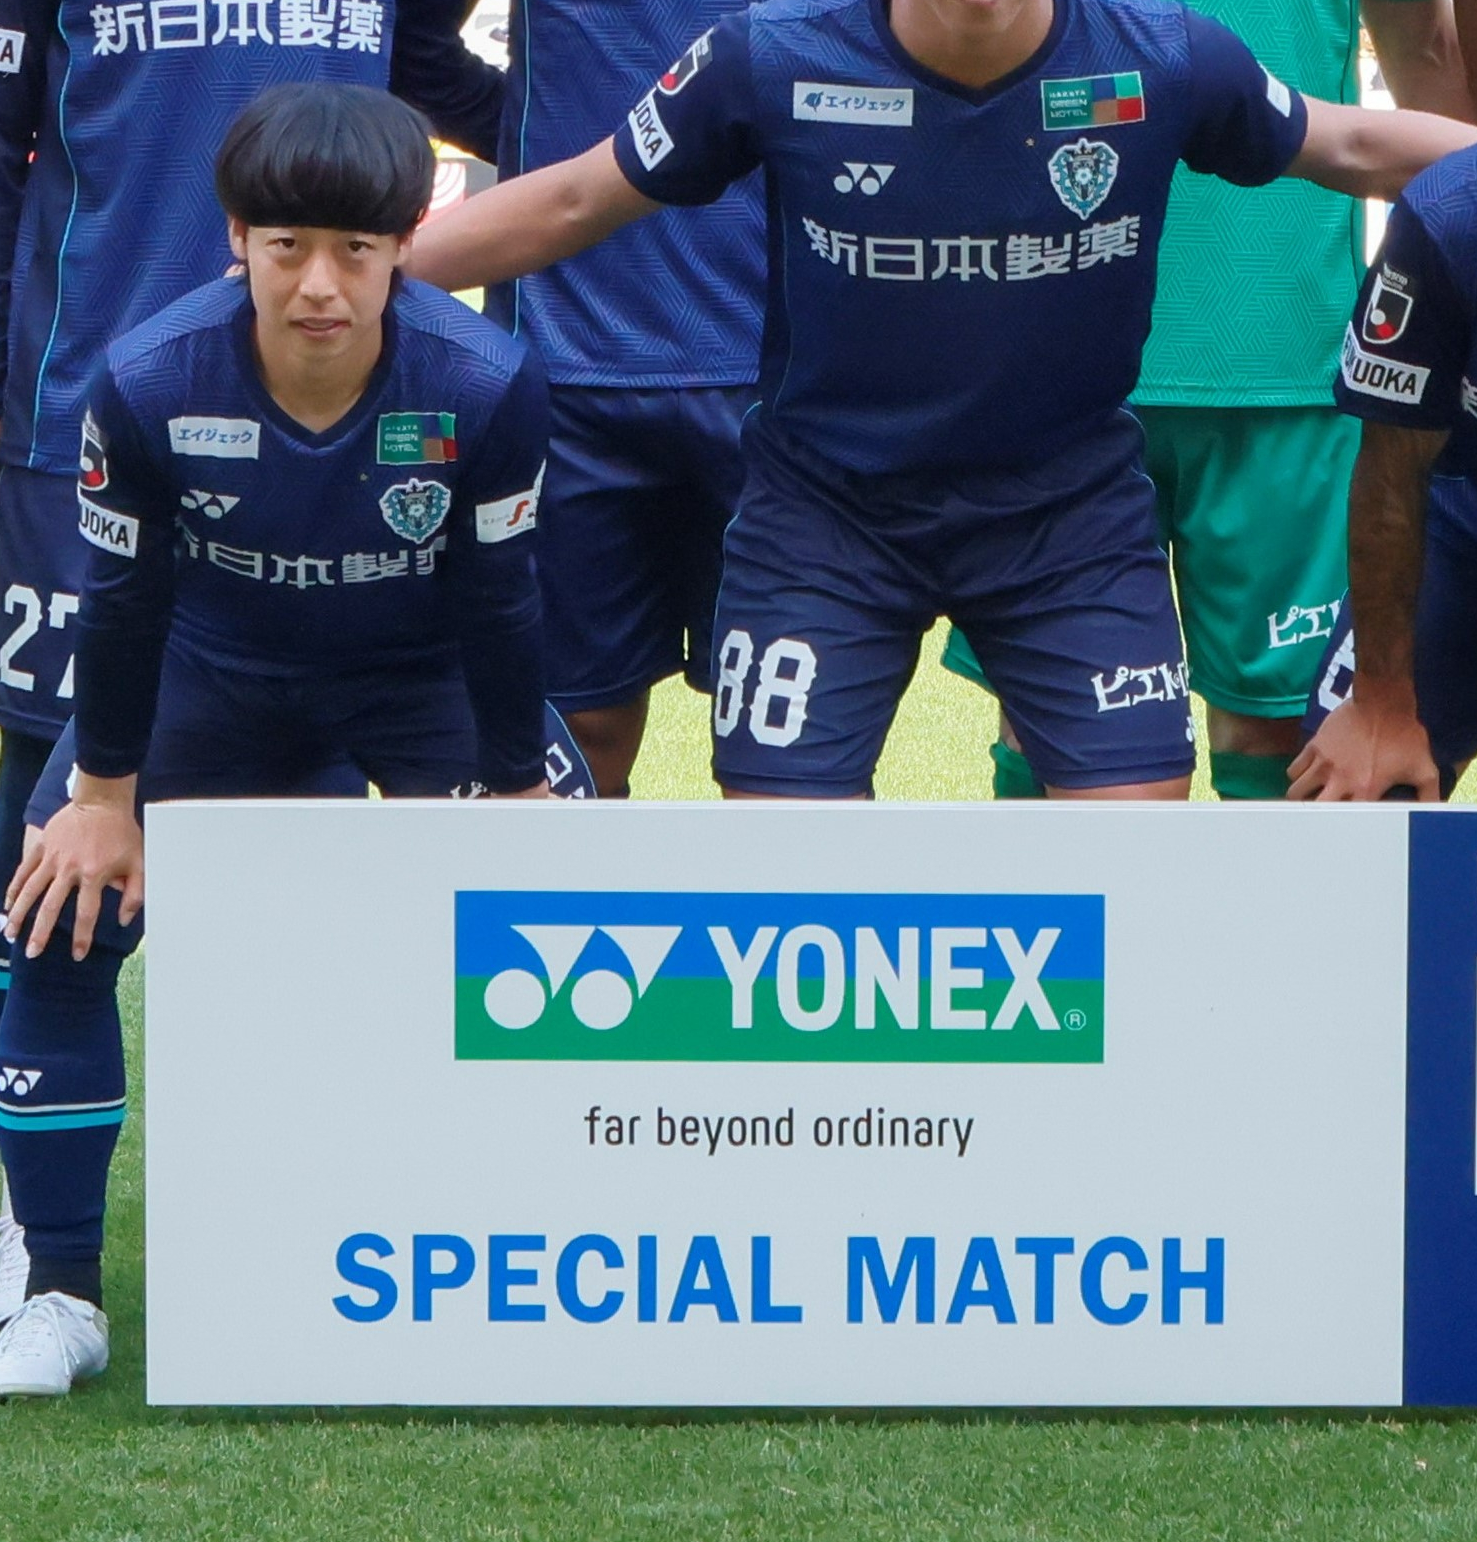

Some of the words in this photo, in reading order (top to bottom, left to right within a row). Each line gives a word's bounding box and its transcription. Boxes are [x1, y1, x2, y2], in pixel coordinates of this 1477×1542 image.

[825, 94, 905, 112] エイジェック
[801, 215, 1141, 282] 新日本製薬
[177, 427, 254, 445] エイジェック
[714, 628, 818, 748] 88
[706, 923, 1063, 1033] YONEX
[584, 1104, 642, 1149] far
[656, 1105, 796, 1157] beyond
[813, 1106, 975, 1158] ordinary
[331, 1232, 804, 1324] SPECIAL
[844, 1234, 1227, 1326] MATCH
